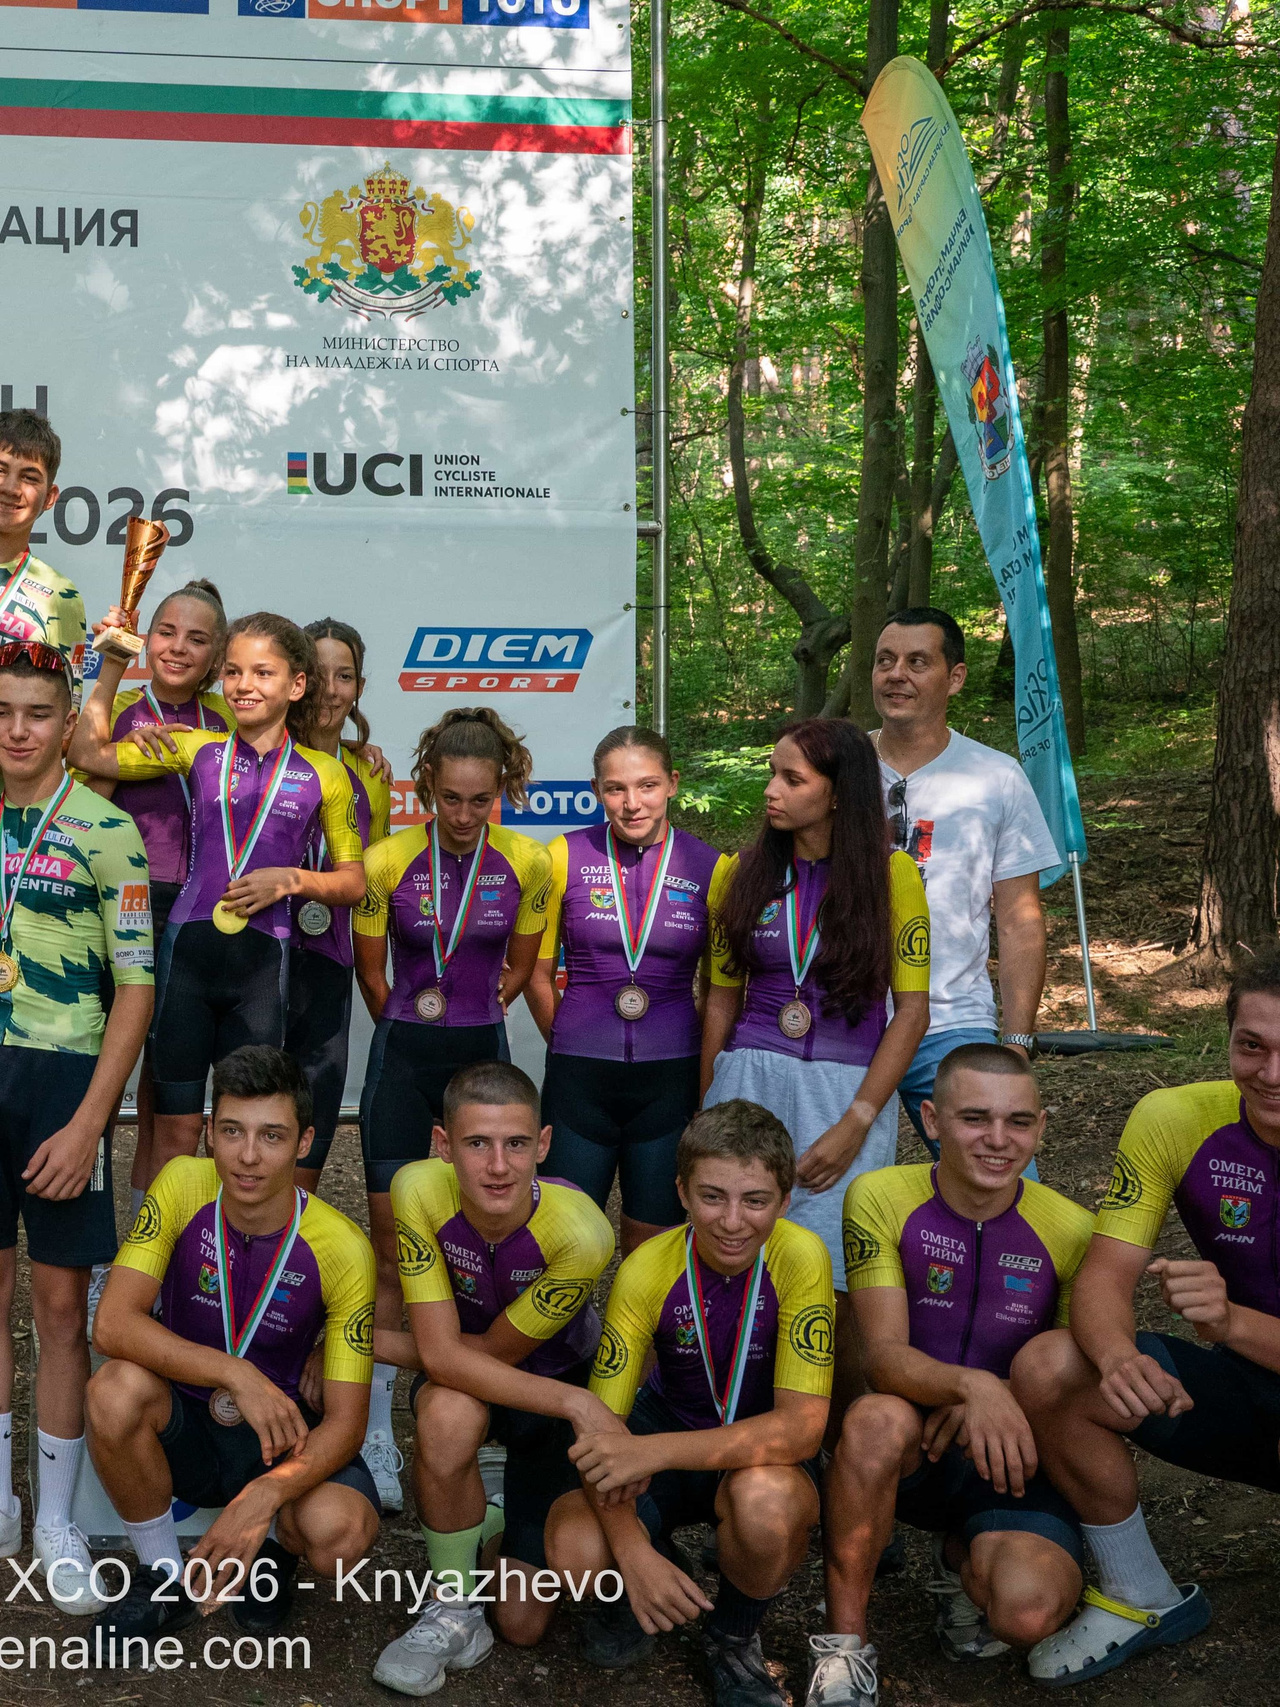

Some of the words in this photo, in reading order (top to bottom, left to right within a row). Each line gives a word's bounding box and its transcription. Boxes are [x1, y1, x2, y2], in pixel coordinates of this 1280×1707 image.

[322, 336, 460, 352] МИНИСТЕРСТВО
[285, 355, 310, 368] НА
[315, 356, 413, 370] МЛАДЕЖТА
[418, 358, 429, 370] И
[434, 358, 500, 372] СПОРТА
[434, 454, 480, 466] UNION
[313, 452, 423, 497] UCI
[434, 470, 496, 482] CYCLISTE
[434, 486, 551, 498] INTERNATIONALE
[26, 487, 194, 546] 026
[416, 634, 580, 662] DIEM
[413, 677, 564, 689] SPORT
[59, 815, 93, 829] DIEM
[413, 872, 451, 882] ОМГА
[580, 865, 629, 874] ОМЕА
[414, 881, 449, 891] ТИМ
[123, 898, 147, 910] TCE
[1209, 1159, 1267, 1182] ОМЕГА
[1211, 1174, 1264, 1195] ТИЙМ
[920, 1229, 967, 1253] ОМЕГА
[444, 1241, 483, 1263] ОМЕГА
[923, 1244, 965, 1265] ТИЙМ
[445, 1252, 483, 1274] ТИЙМ
[1002, 1254, 1040, 1266] DIEM
[995, 1312, 1016, 1323] Bike
